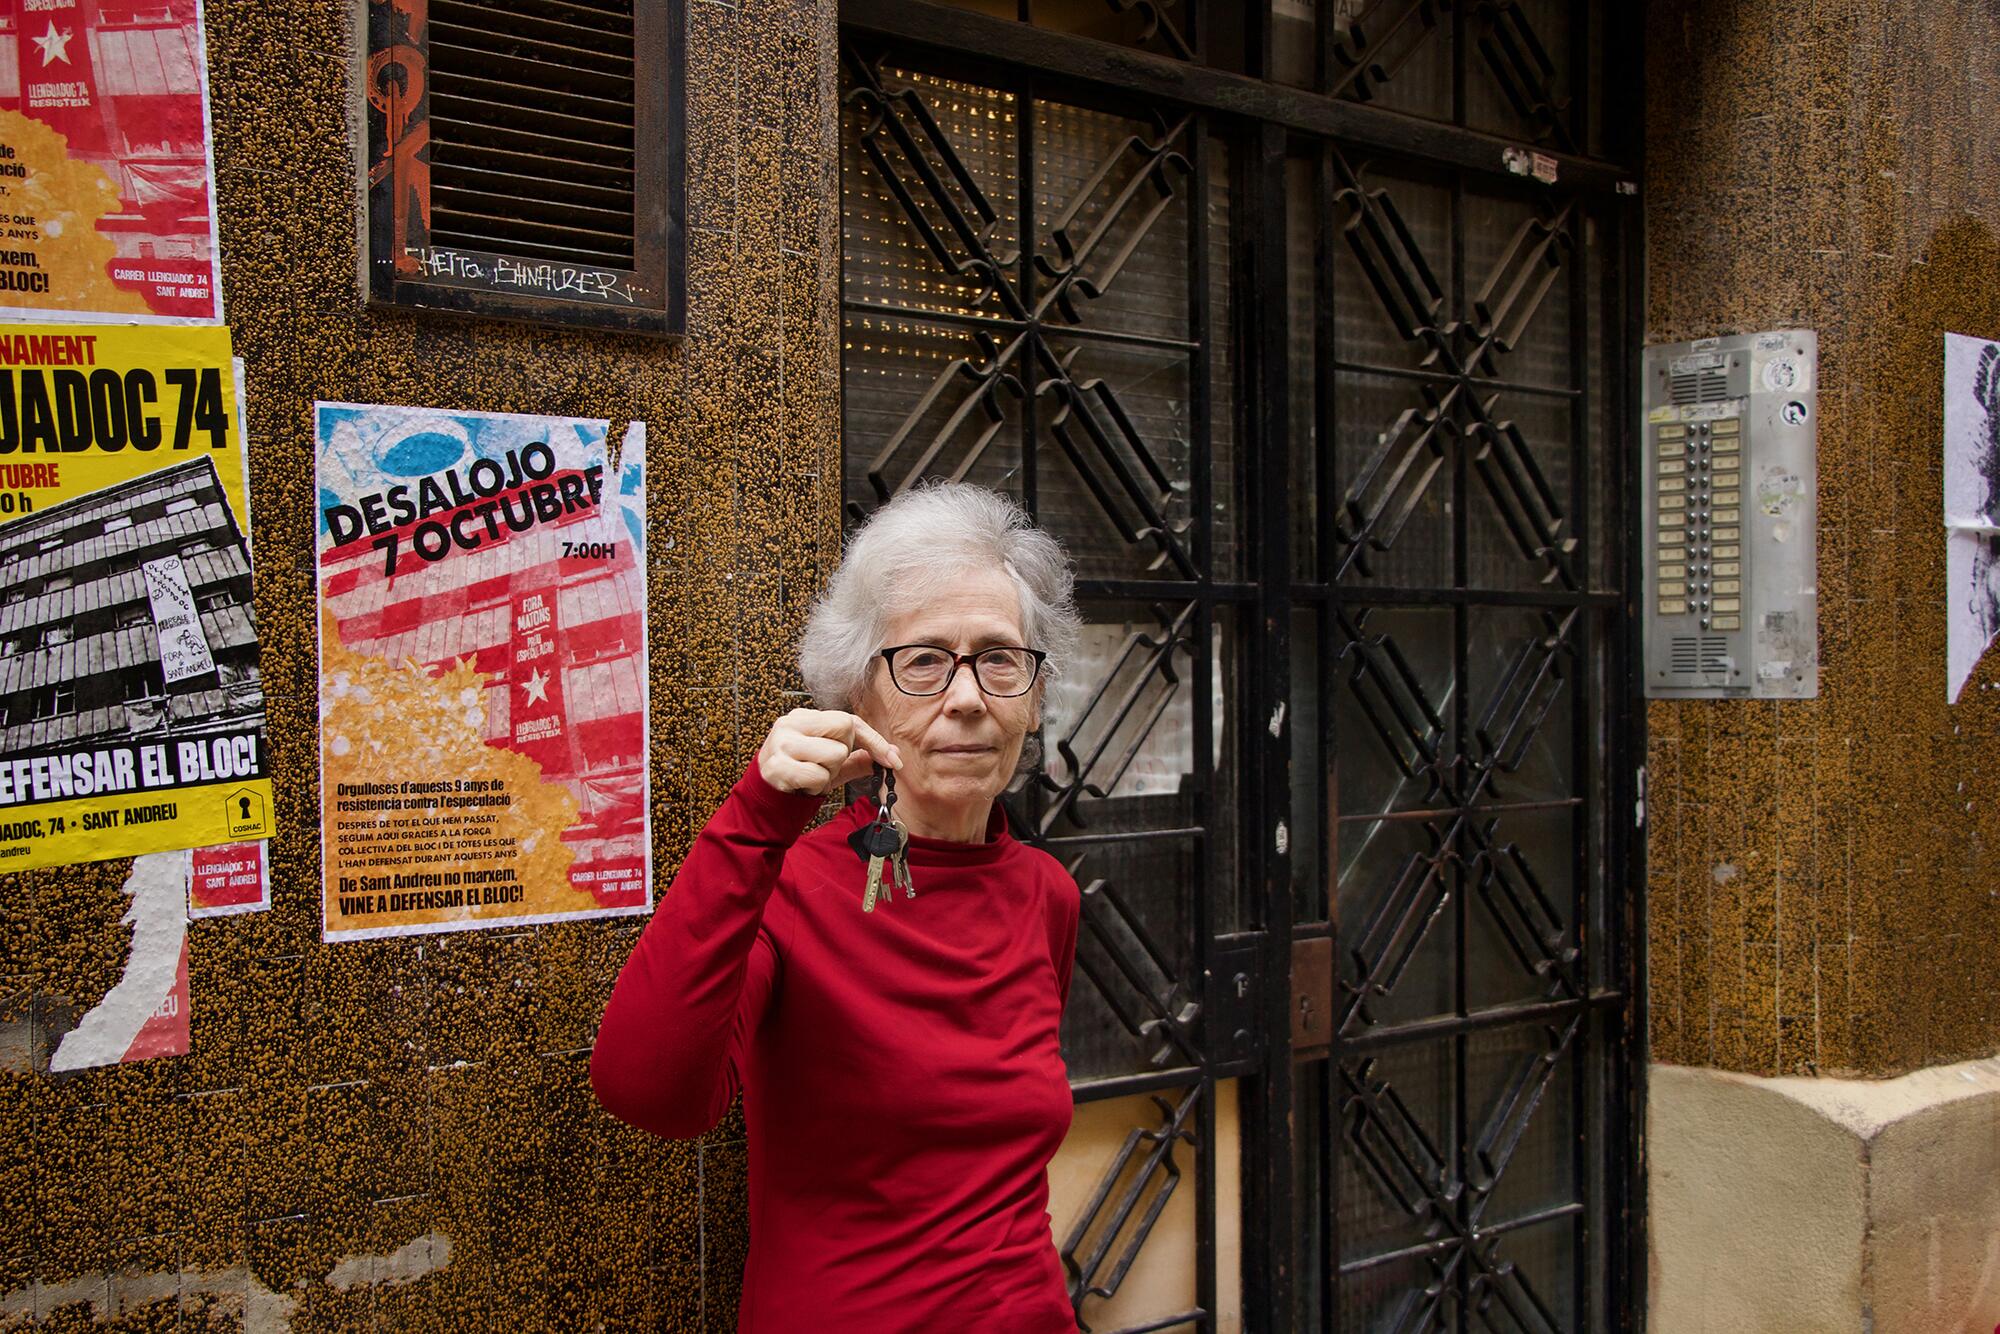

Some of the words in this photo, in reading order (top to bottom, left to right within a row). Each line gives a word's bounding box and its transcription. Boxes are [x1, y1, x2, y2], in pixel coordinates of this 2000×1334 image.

[29, 98, 91, 108] RESISTEIX
[13, 215, 36, 226] QUE
[8, 229, 39, 240] ANYS
[114, 268, 145, 281] CARRER
[148, 271, 194, 284] LLENGUADOC
[197, 274, 208, 285] 74
[156, 285, 176, 297] SANT
[179, 287, 208, 299] ANDREU
[0, 335, 97, 366] NAMENT
[165, 367, 229, 450] 74
[19, 491, 33, 513] h
[324, 441, 556, 547] DESALOJO
[372, 533, 400, 577] 7
[562, 542, 616, 560] 7:00H
[522, 594, 544, 613] FORA
[517, 606, 551, 631] MATONS
[166, 665, 185, 679] SANT
[0, 748, 136, 805] EFENSAR
[140, 743, 175, 788] EL
[177, 734, 260, 784] BLOC!
[337, 782, 399, 797] Orgulloses
[400, 780, 453, 794] d'aquests
[455, 779, 462, 792] 9
[463, 780, 489, 793] anys
[491, 779, 504, 791] de
[337, 797, 401, 811] resistencia
[403, 796, 439, 809] contra
[440, 792, 511, 809] l'especulació
[48, 817, 65, 835] 74
[82, 810, 119, 831] SANT
[124, 803, 178, 825] ANDREU
[233, 822, 261, 833] COSHAC
[379, 820, 391, 828] DE
[393, 819, 410, 827] TOT
[412, 818, 421, 827] EL
[422, 817, 441, 826] QUE
[442, 816, 462, 825] HEM
[464, 814, 500, 823] PASSAT,
[338, 833, 374, 843] SEGUIM
[440, 829, 447, 837] A
[449, 829, 461, 837] LA
[463, 827, 491, 836] FORÇA
[0, 846, 31, 858] andreu
[396, 844, 412, 852] DEL
[414, 842, 437, 851] BLOC
[443, 841, 455, 849] DE
[456, 839, 482, 849] TOTES
[483, 838, 498, 847] LES
[499, 838, 516, 847] QUE
[338, 858, 366, 868] L'HAN
[368, 856, 413, 867] DEFENSAT
[414, 853, 452, 864] DURANT
[453, 851, 493, 861] AQUESTS
[494, 849, 518, 859] ANYS
[198, 861, 244, 876] LLENGUADOC
[246, 860, 256, 873] 74
[206, 876, 225, 889] SANT
[229, 874, 257, 887] ANDREU
[339, 877, 358, 893] De
[360, 875, 392, 892] Sant
[393, 872, 442, 889] Andreu
[444, 872, 461, 885] no
[463, 868, 518, 884] marxem,
[602, 882, 618, 893] SANT
[339, 895, 374, 916] VINE
[377, 895, 388, 912] A
[390, 889, 464, 912] DEFENSAR
[466, 888, 482, 906] EL
[483, 885, 524, 905] BLOC!
